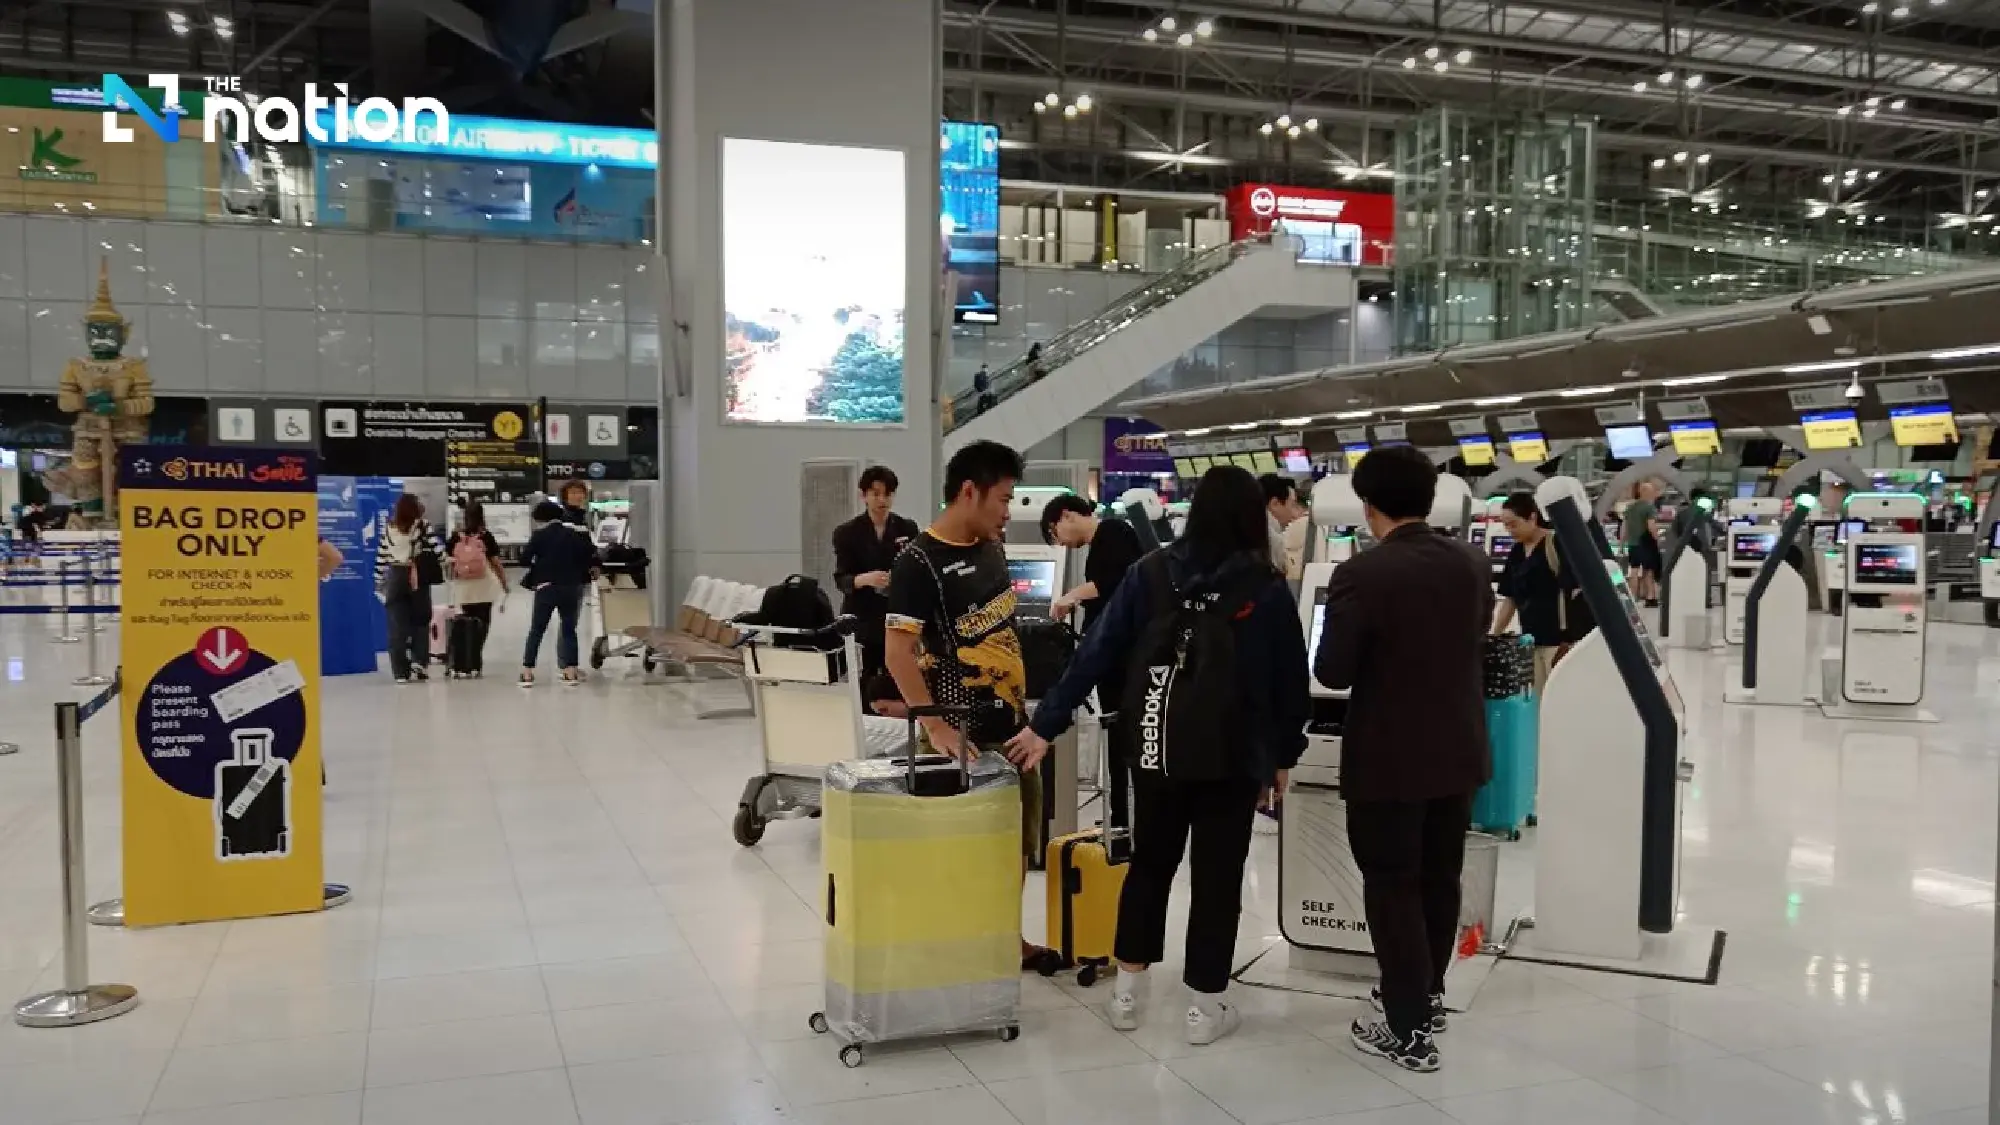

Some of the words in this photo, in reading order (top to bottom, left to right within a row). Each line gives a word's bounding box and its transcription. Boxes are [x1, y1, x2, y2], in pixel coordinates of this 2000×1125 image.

[189, 461, 245, 478] THAI
[134, 505, 204, 530] BAG
[215, 507, 307, 530] DROP
[176, 533, 266, 557] ONLY
[147, 568, 174, 580] FOR
[177, 568, 240, 580] INTERNET
[243, 568, 252, 580] &
[256, 568, 294, 580] KIOSK
[191, 581, 252, 590] CHECK-IN
[152, 683, 192, 694] Please
[152, 697, 198, 709] present
[152, 706, 209, 718] boarding
[152, 721, 181, 732] pass
[1140, 687, 1163, 770] Reebok
[1302, 900, 1335, 914] SELF
[1301, 915, 1367, 932] CHECK-IN
